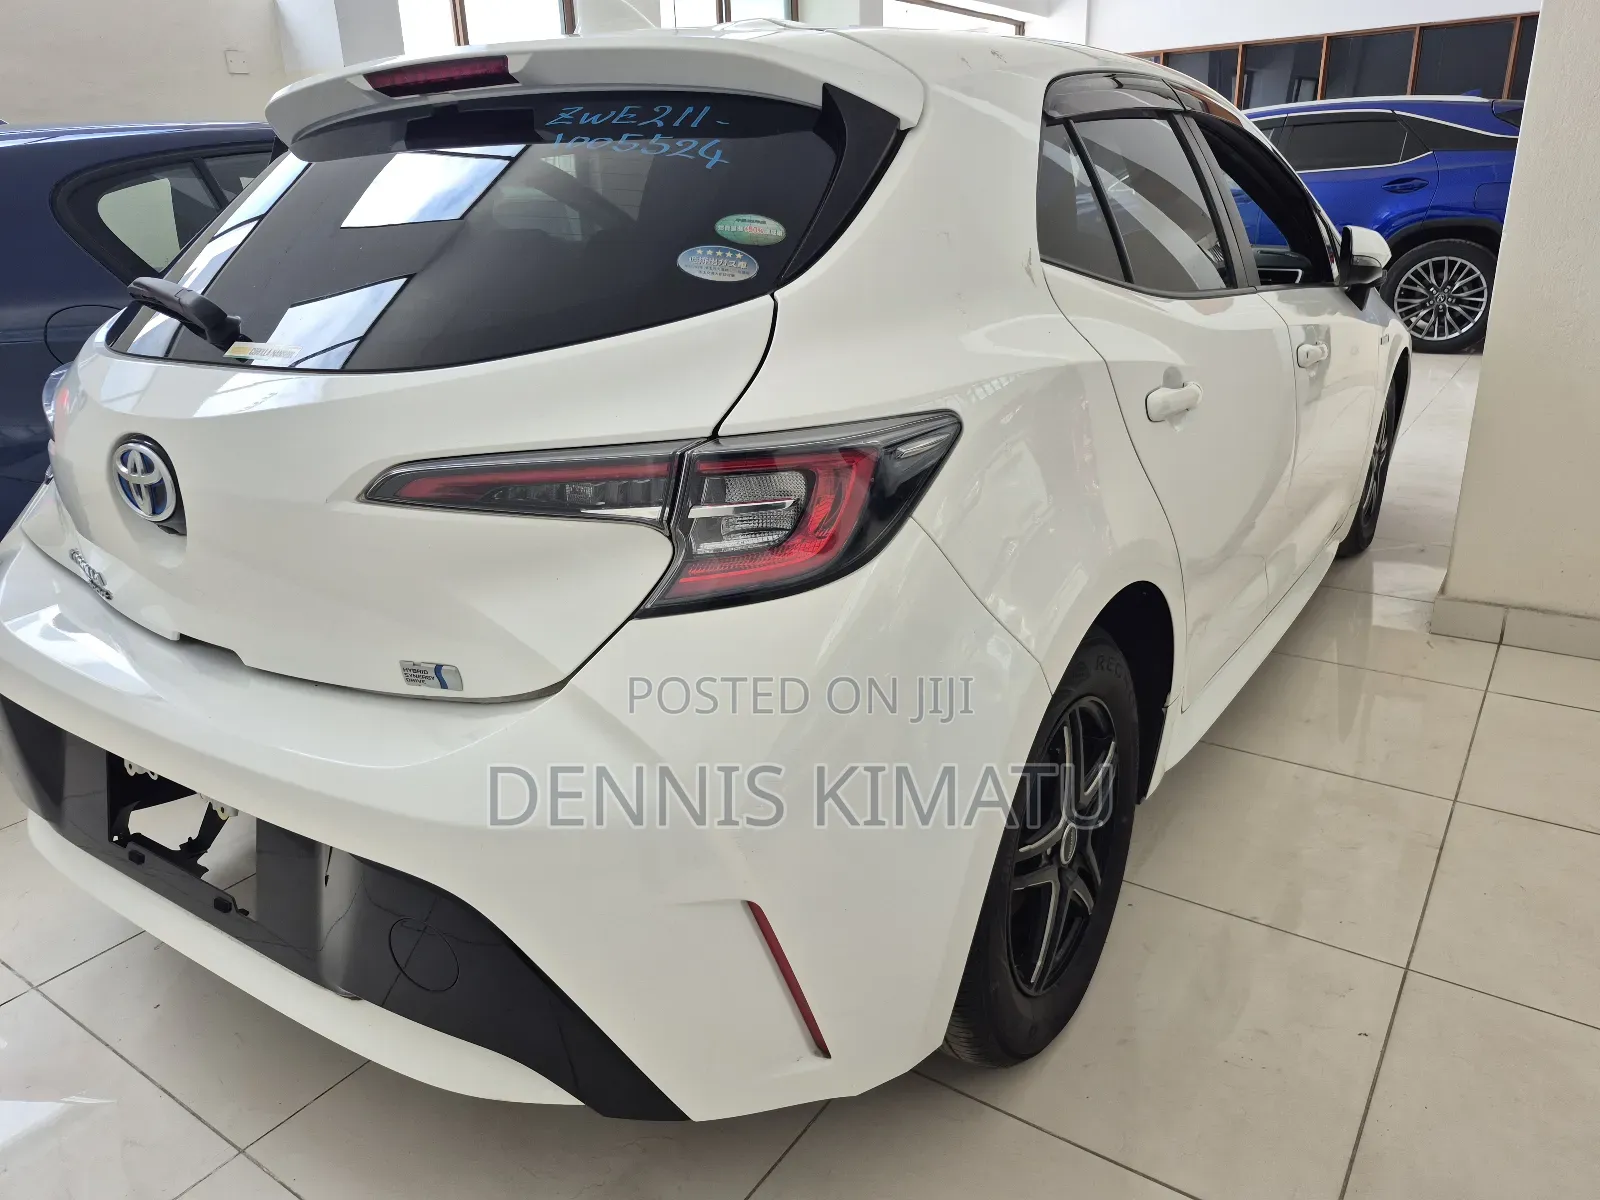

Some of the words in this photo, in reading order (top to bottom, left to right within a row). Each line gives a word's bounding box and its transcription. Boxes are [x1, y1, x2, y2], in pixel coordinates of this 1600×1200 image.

[551, 133, 730, 170] 1005524
[402, 667, 429, 675] HYBRID
[404, 672, 435, 681] SYNERGY
[405, 677, 427, 685] DRIVE
